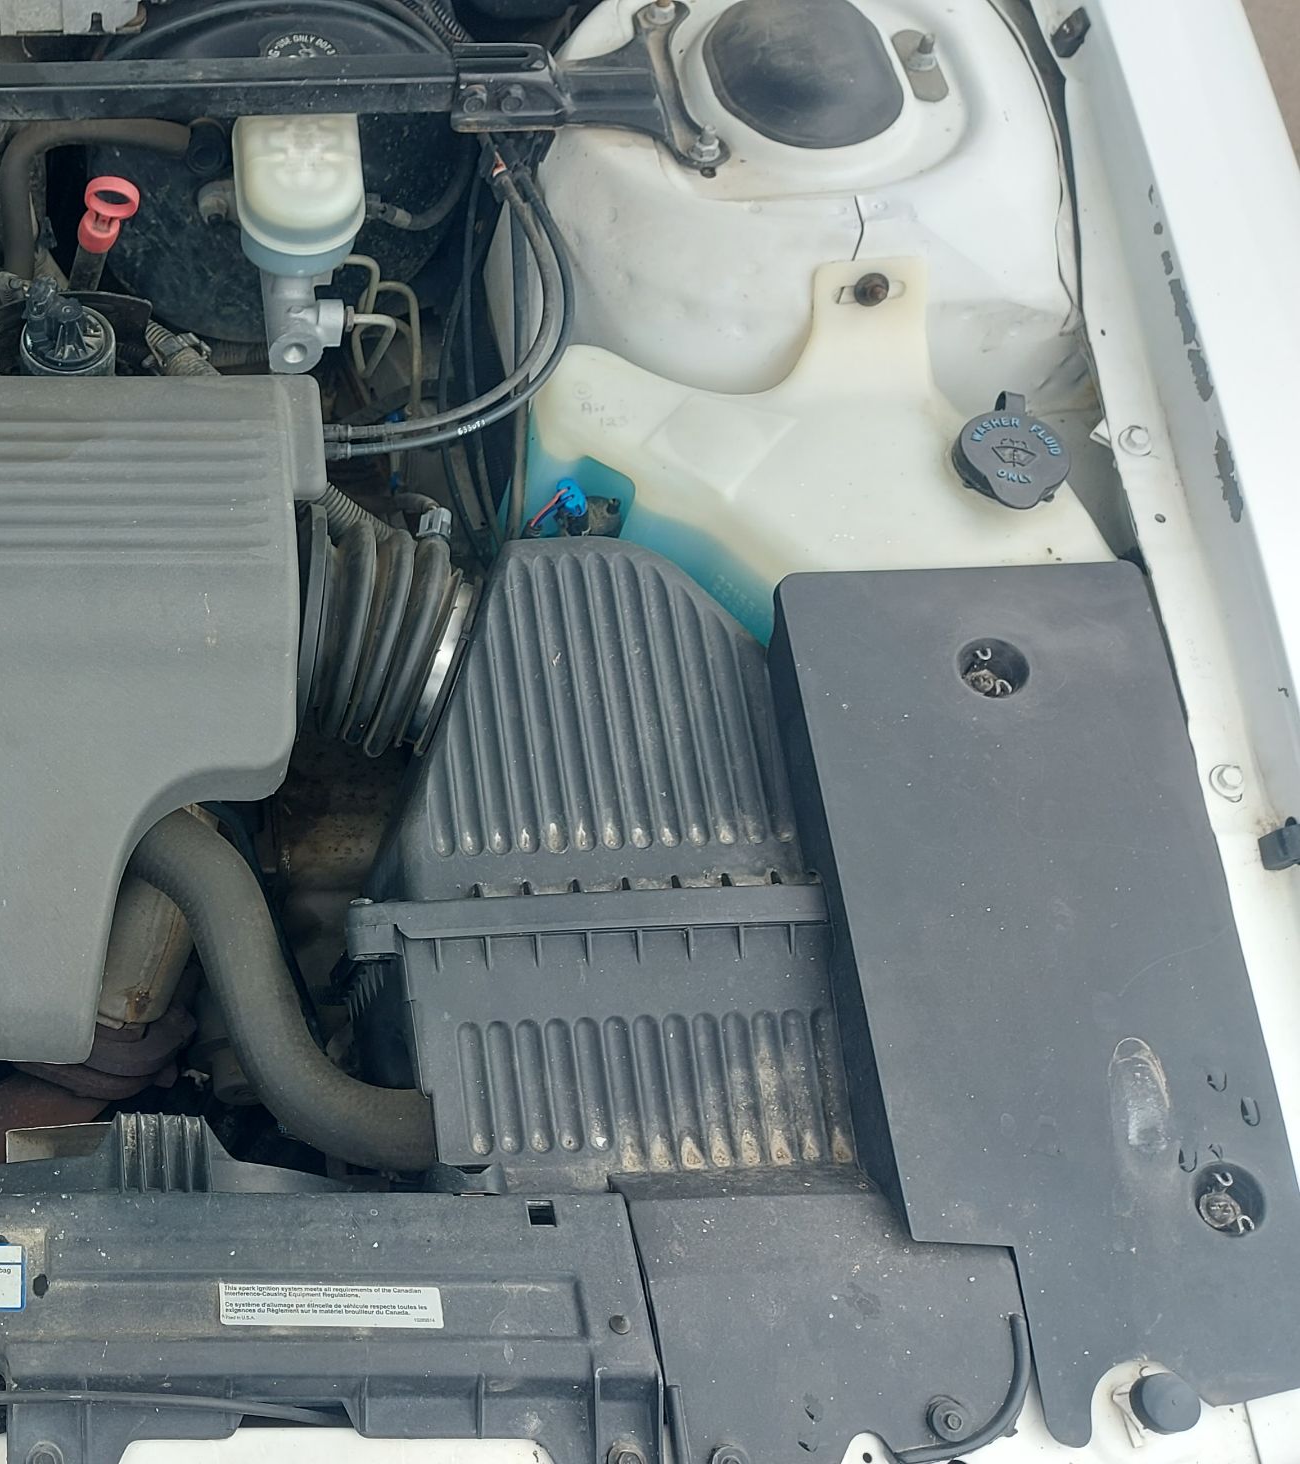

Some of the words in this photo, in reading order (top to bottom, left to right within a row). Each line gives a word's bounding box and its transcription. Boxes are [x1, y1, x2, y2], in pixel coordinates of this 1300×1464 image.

[971, 417, 1020, 442] WASHER
[1029, 424, 1062, 456] FLUID
[996, 469, 1031, 484] ONLY
